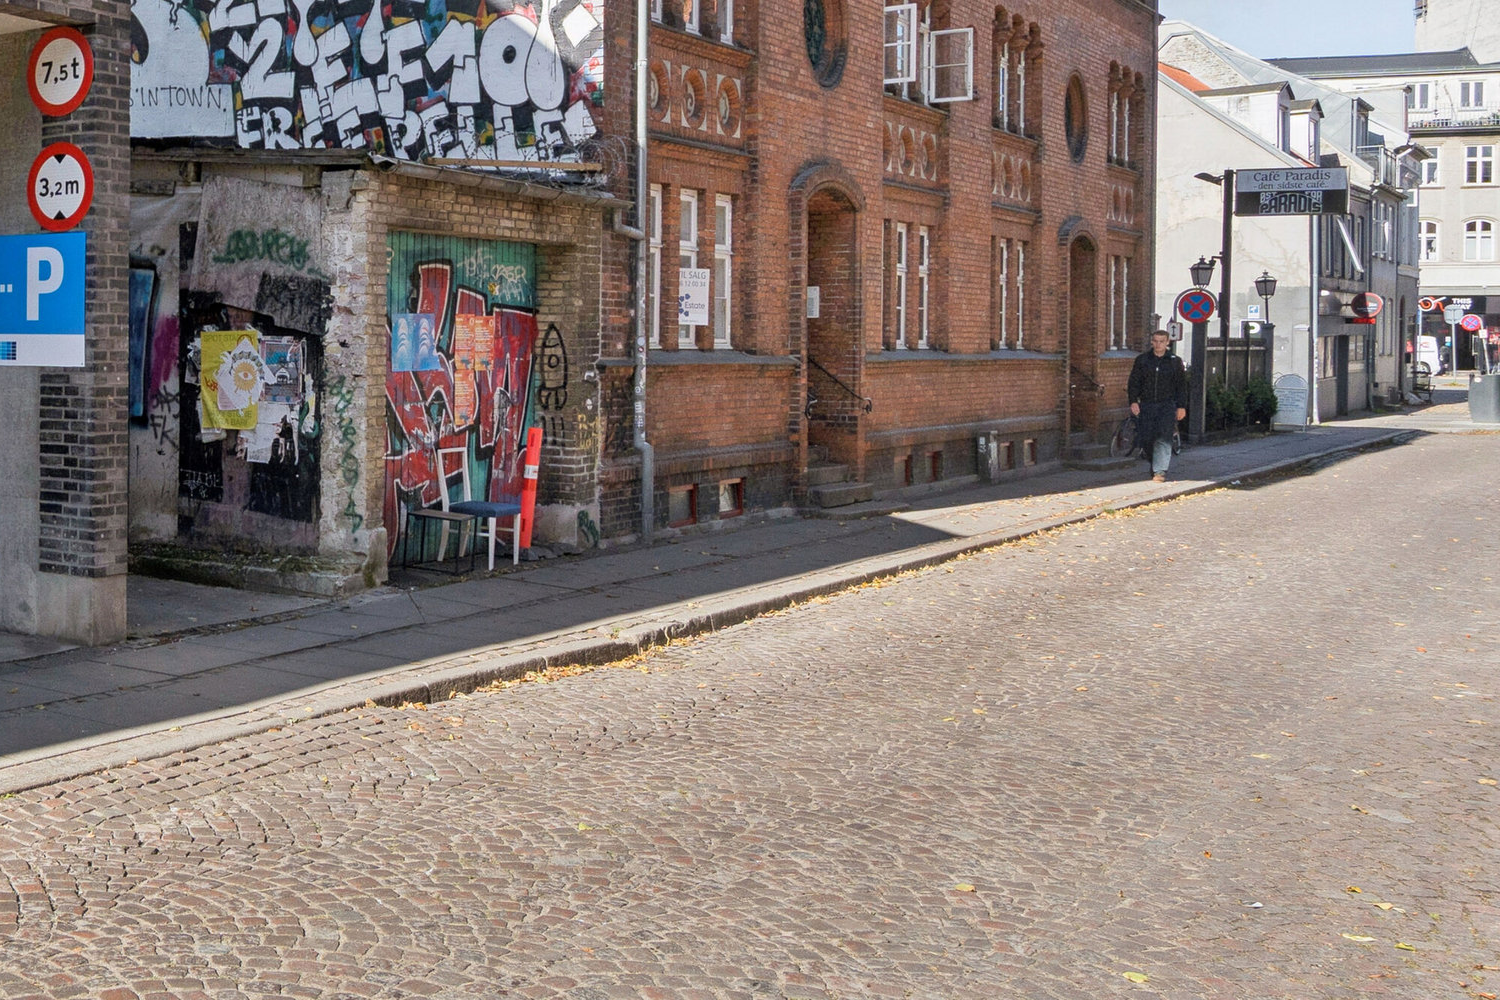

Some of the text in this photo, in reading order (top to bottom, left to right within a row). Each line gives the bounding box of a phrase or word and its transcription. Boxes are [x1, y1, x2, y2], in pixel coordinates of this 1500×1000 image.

[1253, 170, 1331, 182] Café Paradis
[1259, 193, 1323, 213] PARADIS
[688, 271, 707, 280] SALG
[26, 246, 64, 321] P
[684, 301, 705, 310] Estate
